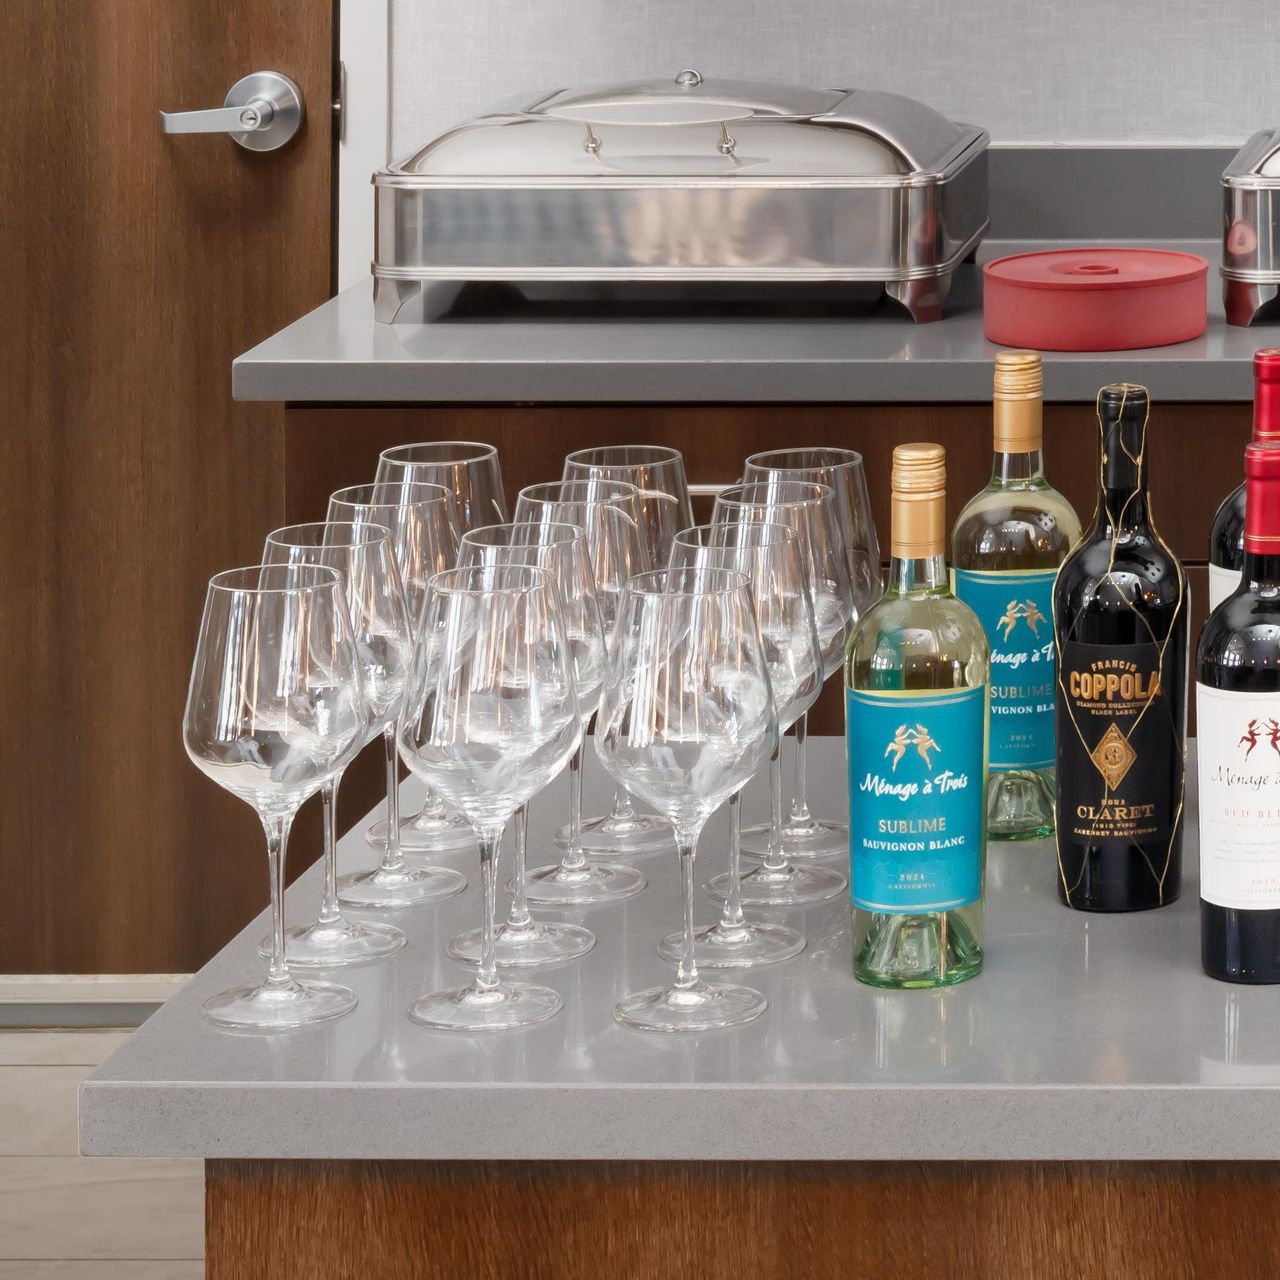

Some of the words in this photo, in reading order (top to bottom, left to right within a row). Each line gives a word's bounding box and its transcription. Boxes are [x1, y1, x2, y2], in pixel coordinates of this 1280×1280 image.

[990, 648, 1028, 670] énage
[1091, 660, 1138, 673] FRANCIS
[990, 683, 1053, 699] SUBLIME
[1070, 671, 1162, 701] COPPOLA
[991, 705, 1034, 715] VIGNON
[1115, 708, 1138, 716] LABEL
[859, 772, 919, 801] Ménage
[922, 780, 932, 795] à
[934, 770, 969, 794] Trois
[1077, 804, 1155, 821] CLARET
[1224, 807, 1249, 819] RED
[878, 817, 947, 834] SUBLIME
[862, 838, 925, 852] SAUVIGNON
[929, 835, 965, 850] BLANC
